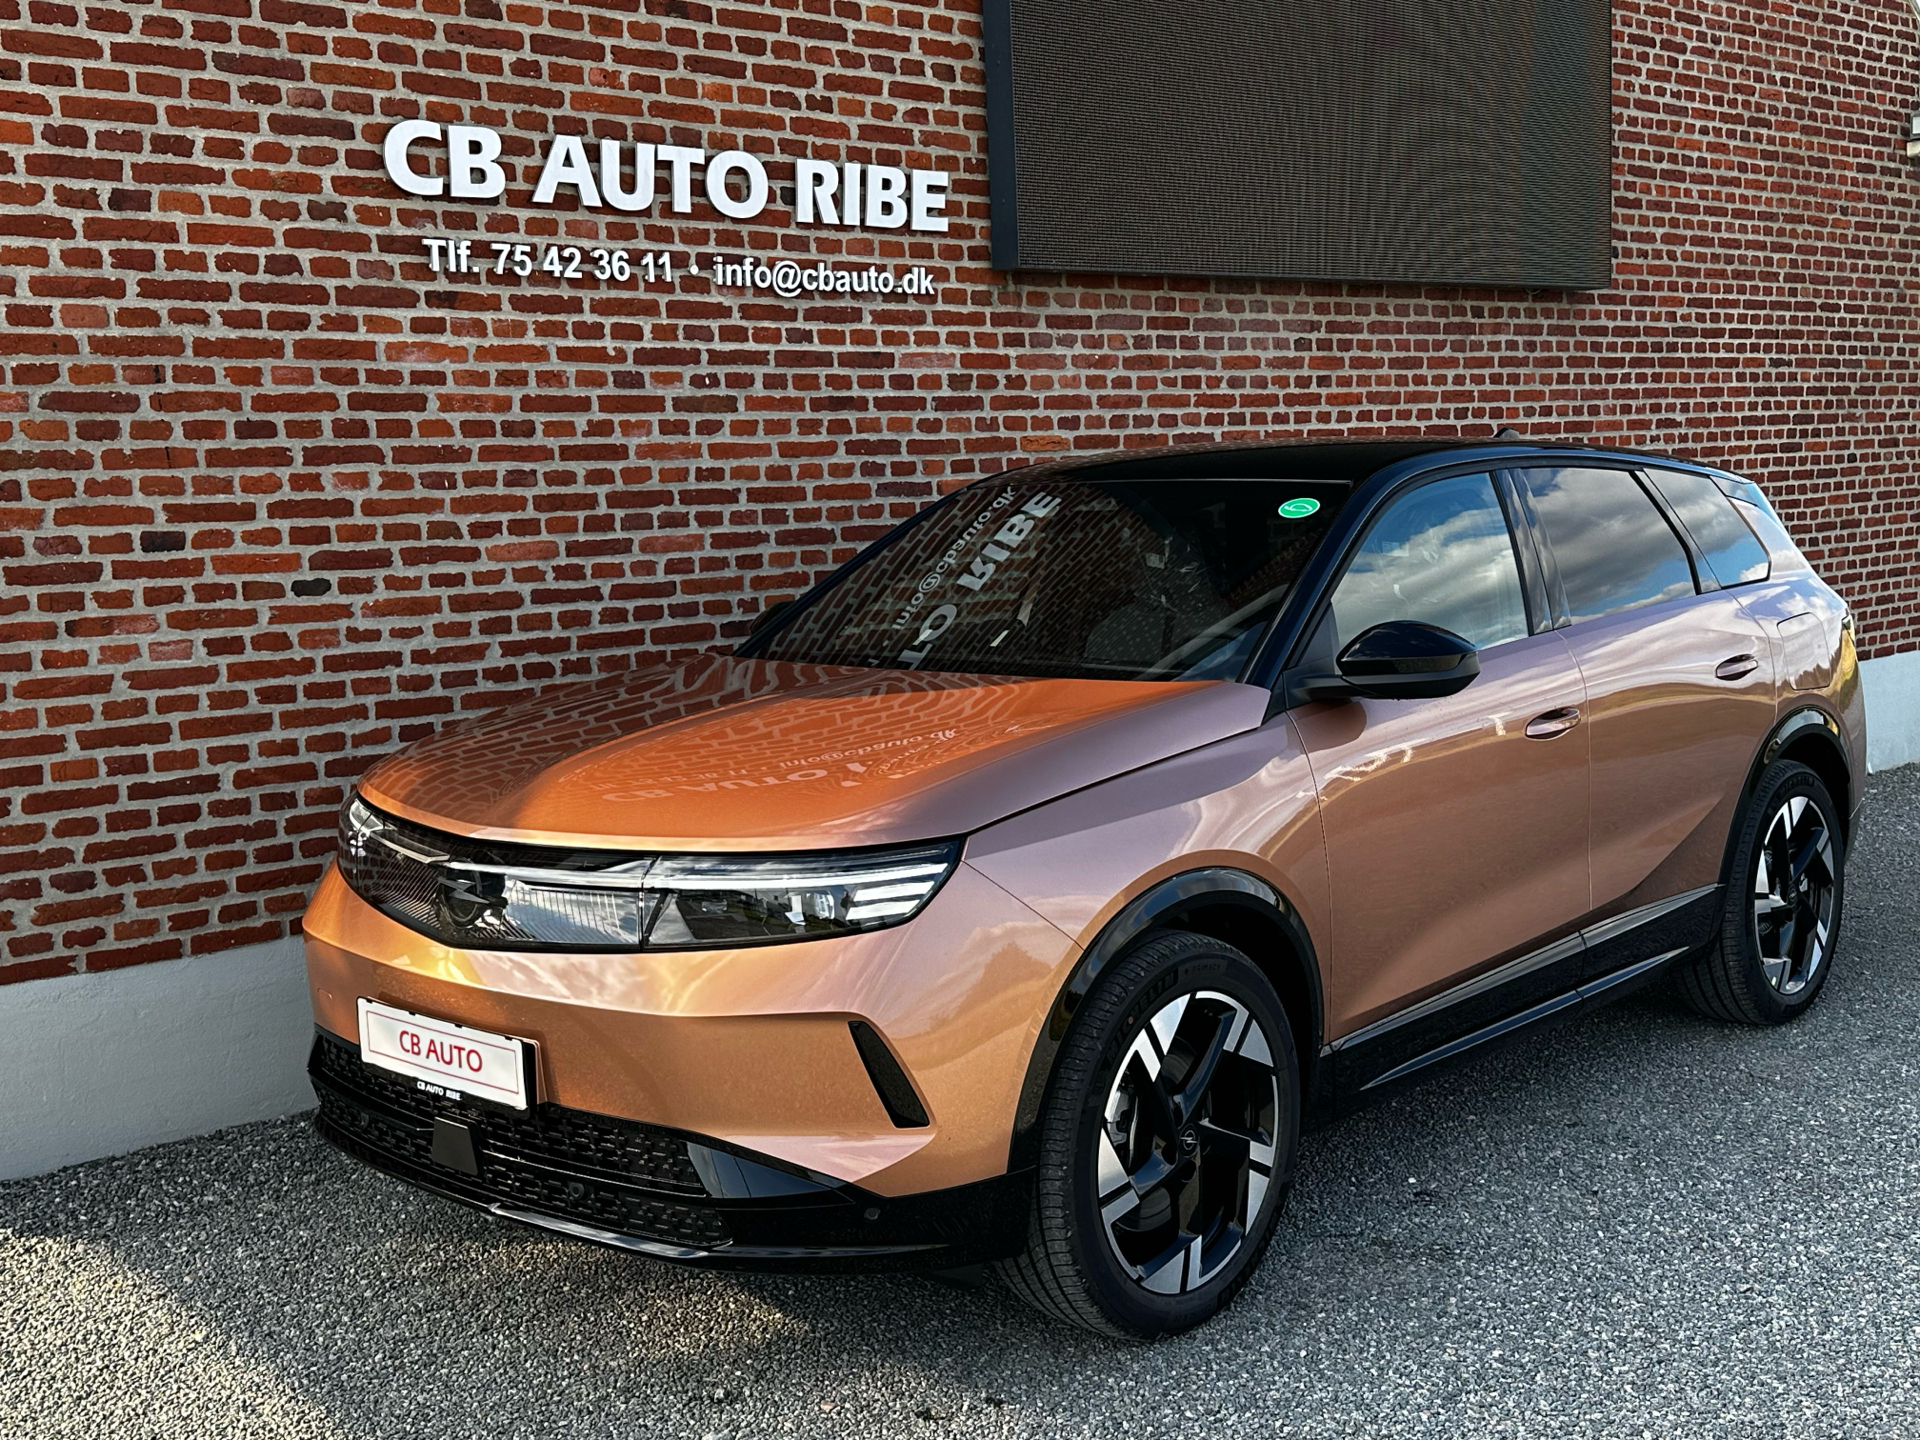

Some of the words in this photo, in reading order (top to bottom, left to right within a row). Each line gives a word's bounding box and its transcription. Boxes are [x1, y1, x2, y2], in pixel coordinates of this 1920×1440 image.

[383, 119, 506, 199] CB
[532, 134, 769, 219] AUTO
[795, 158, 950, 232] RIBE
[422, 238, 480, 274] Tlf.
[494, 242, 533, 278] 75
[542, 246, 584, 280] 42
[593, 248, 631, 282] 36
[641, 251, 673, 284] 11
[714, 256, 935, 298] info@cbauto.dk
[399, 1030, 421, 1056] CB
[426, 1038, 483, 1073] AUTO
[426, 1084, 444, 1096] AUTO
